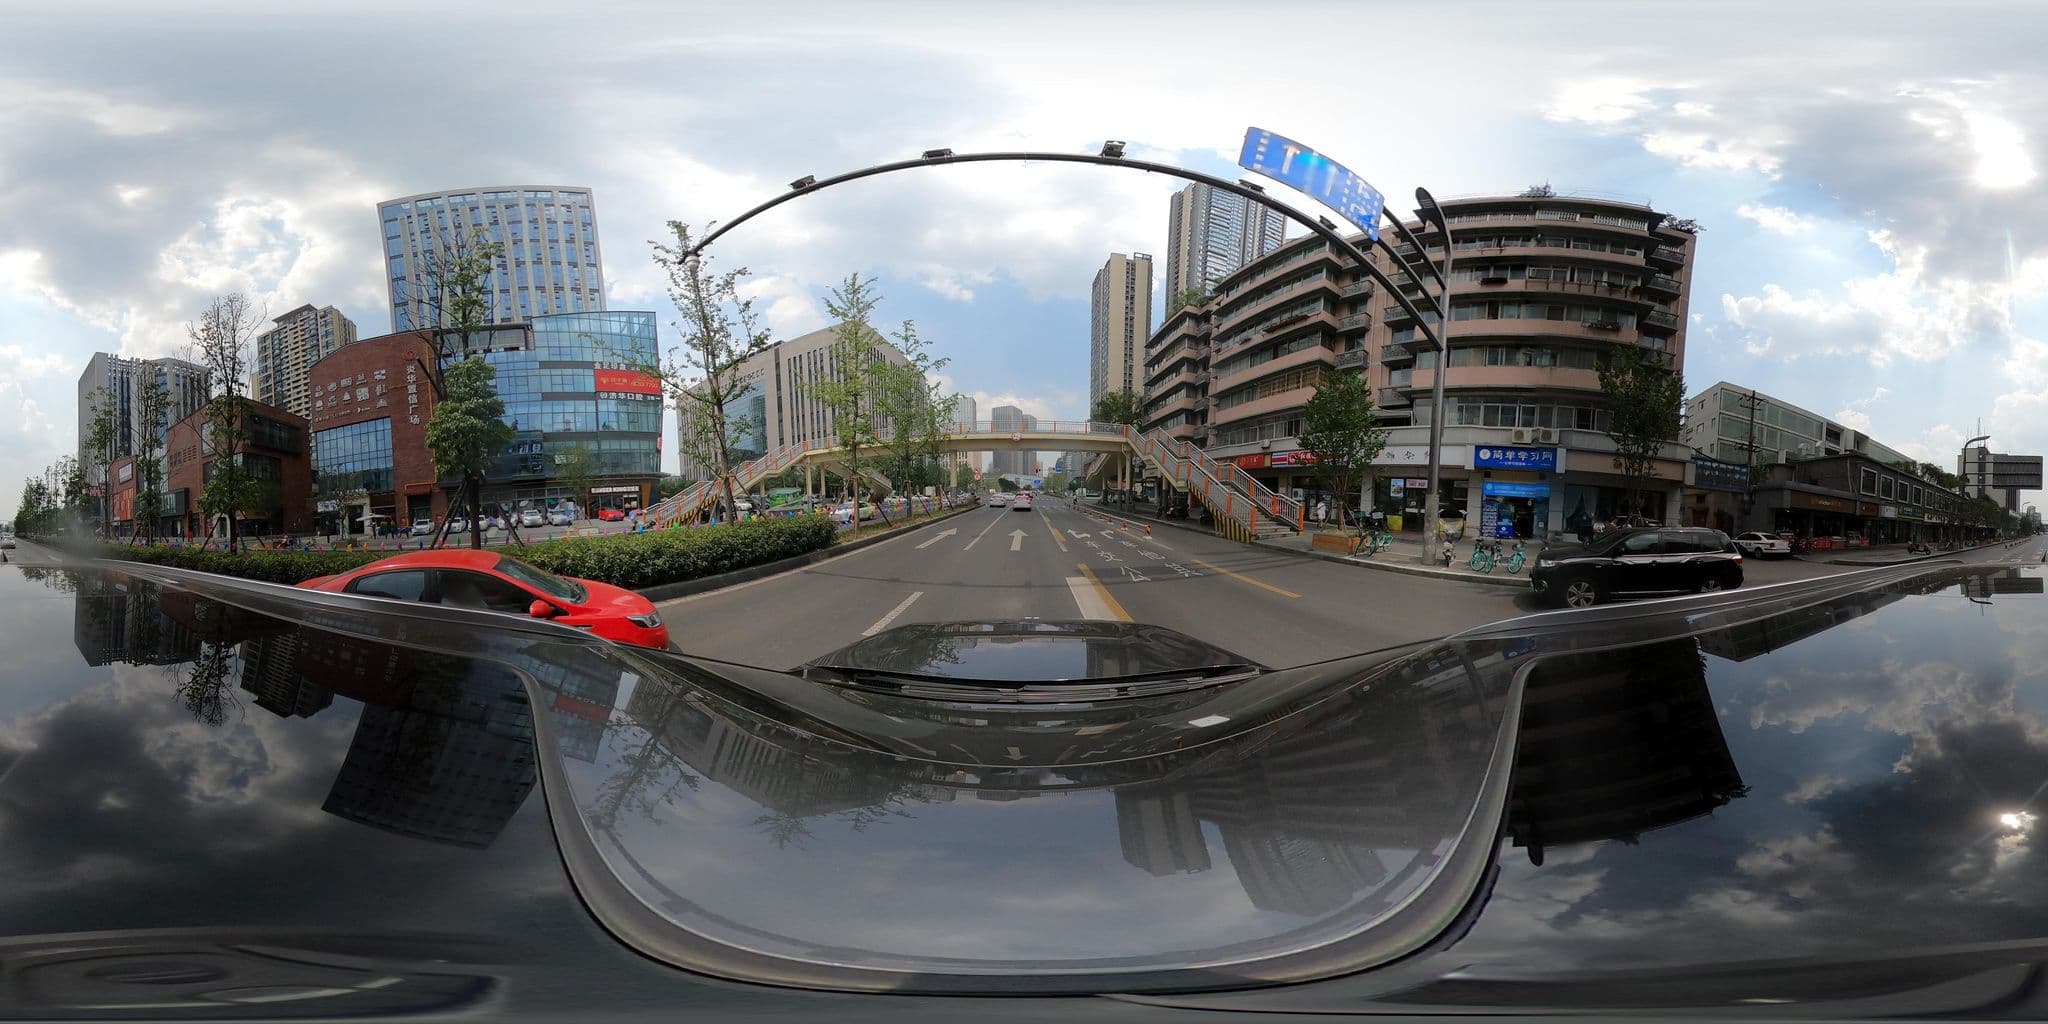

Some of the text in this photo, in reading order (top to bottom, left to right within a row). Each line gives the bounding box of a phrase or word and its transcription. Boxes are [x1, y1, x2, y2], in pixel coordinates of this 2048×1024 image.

[1492, 450, 1552, 461] 简单学习网
